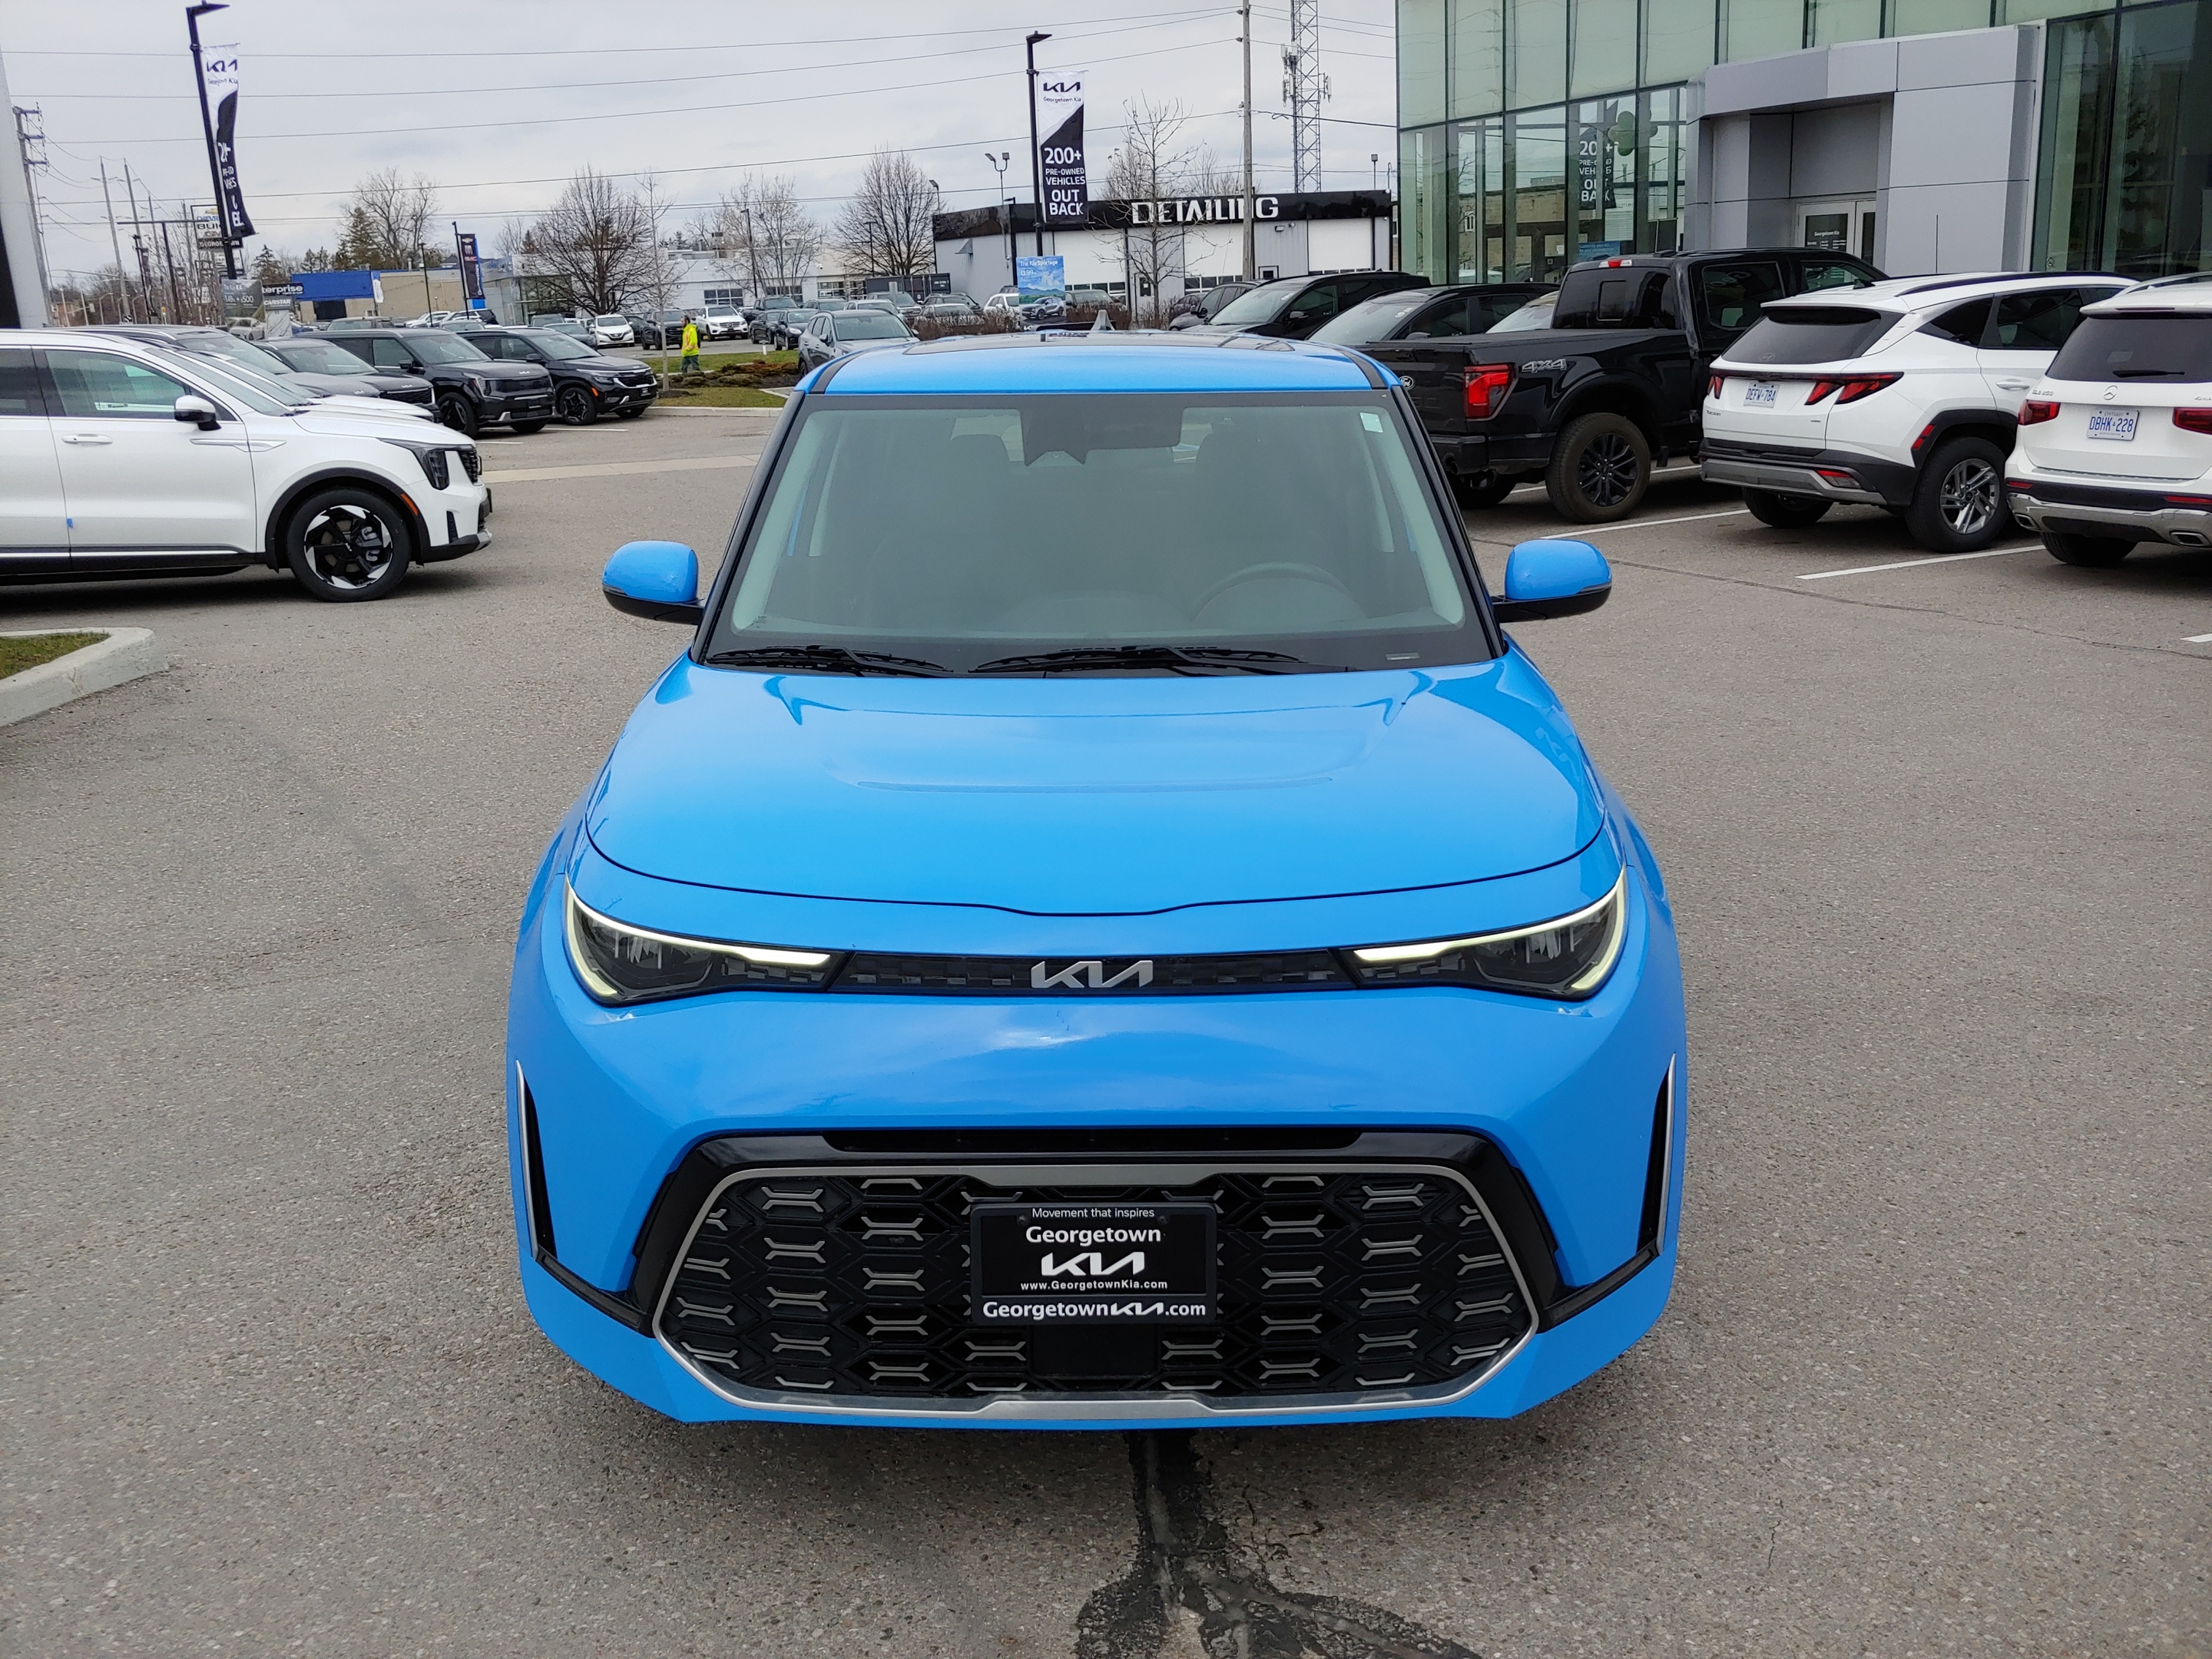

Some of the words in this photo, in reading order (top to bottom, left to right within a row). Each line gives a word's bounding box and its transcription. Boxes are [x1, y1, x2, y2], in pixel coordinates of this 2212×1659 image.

[1043, 81, 1081, 92] KIA
[1580, 141, 1612, 156] 20+
[1045, 147, 1081, 164] 200+
[1045, 177, 1085, 185] VEHICLES
[1051, 189, 1079, 202] OUT
[1581, 190, 1610, 201] BAK
[1049, 203, 1084, 215] BACK
[262, 285, 303, 294] terprise
[1745, 389, 1763, 401] DEFW
[1763, 390, 1777, 402] 784
[2089, 416, 2112, 431] DBHK
[2116, 418, 2134, 432] 228
[1031, 960, 1153, 988] KIA
[1032, 1208, 1088, 1218] Movement
[1091, 1208, 1111, 1218] that
[1114, 1208, 1154, 1219] inspires
[1025, 1226, 1161, 1247] Georgetown
[1041, 1251, 1145, 1277] KIA
[1021, 1280, 1167, 1290] www.GeorgetownKia.com
